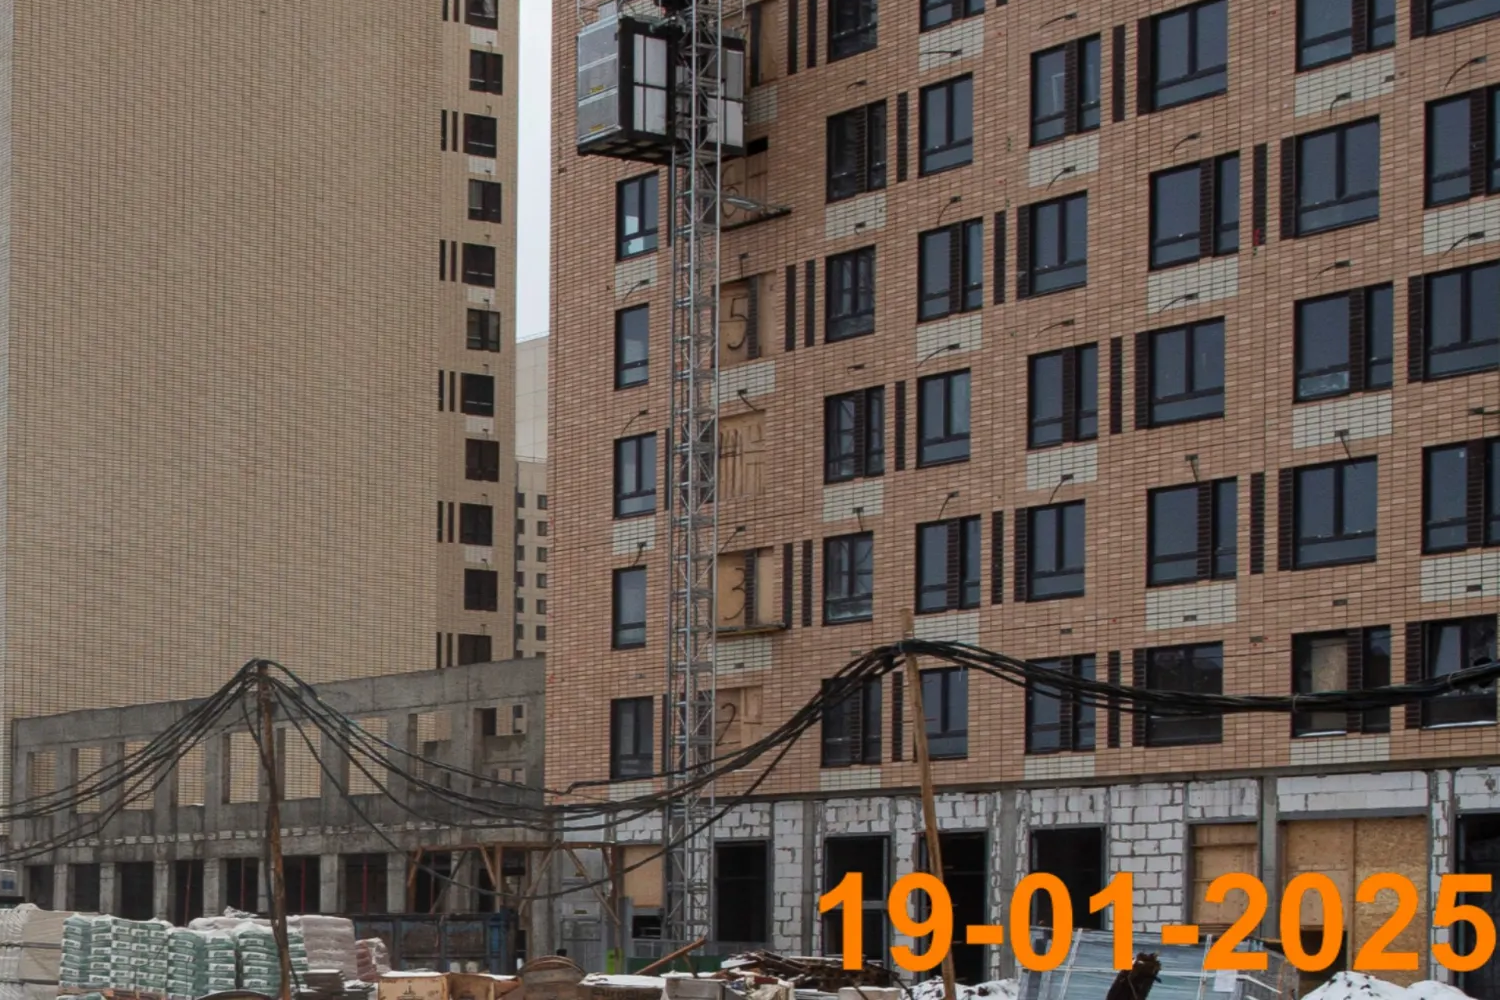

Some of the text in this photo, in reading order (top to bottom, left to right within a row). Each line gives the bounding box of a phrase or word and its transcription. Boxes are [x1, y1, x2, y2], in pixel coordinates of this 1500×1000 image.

[727, 293, 749, 350] 5
[723, 567, 746, 621] 3
[715, 702, 742, 747] 2
